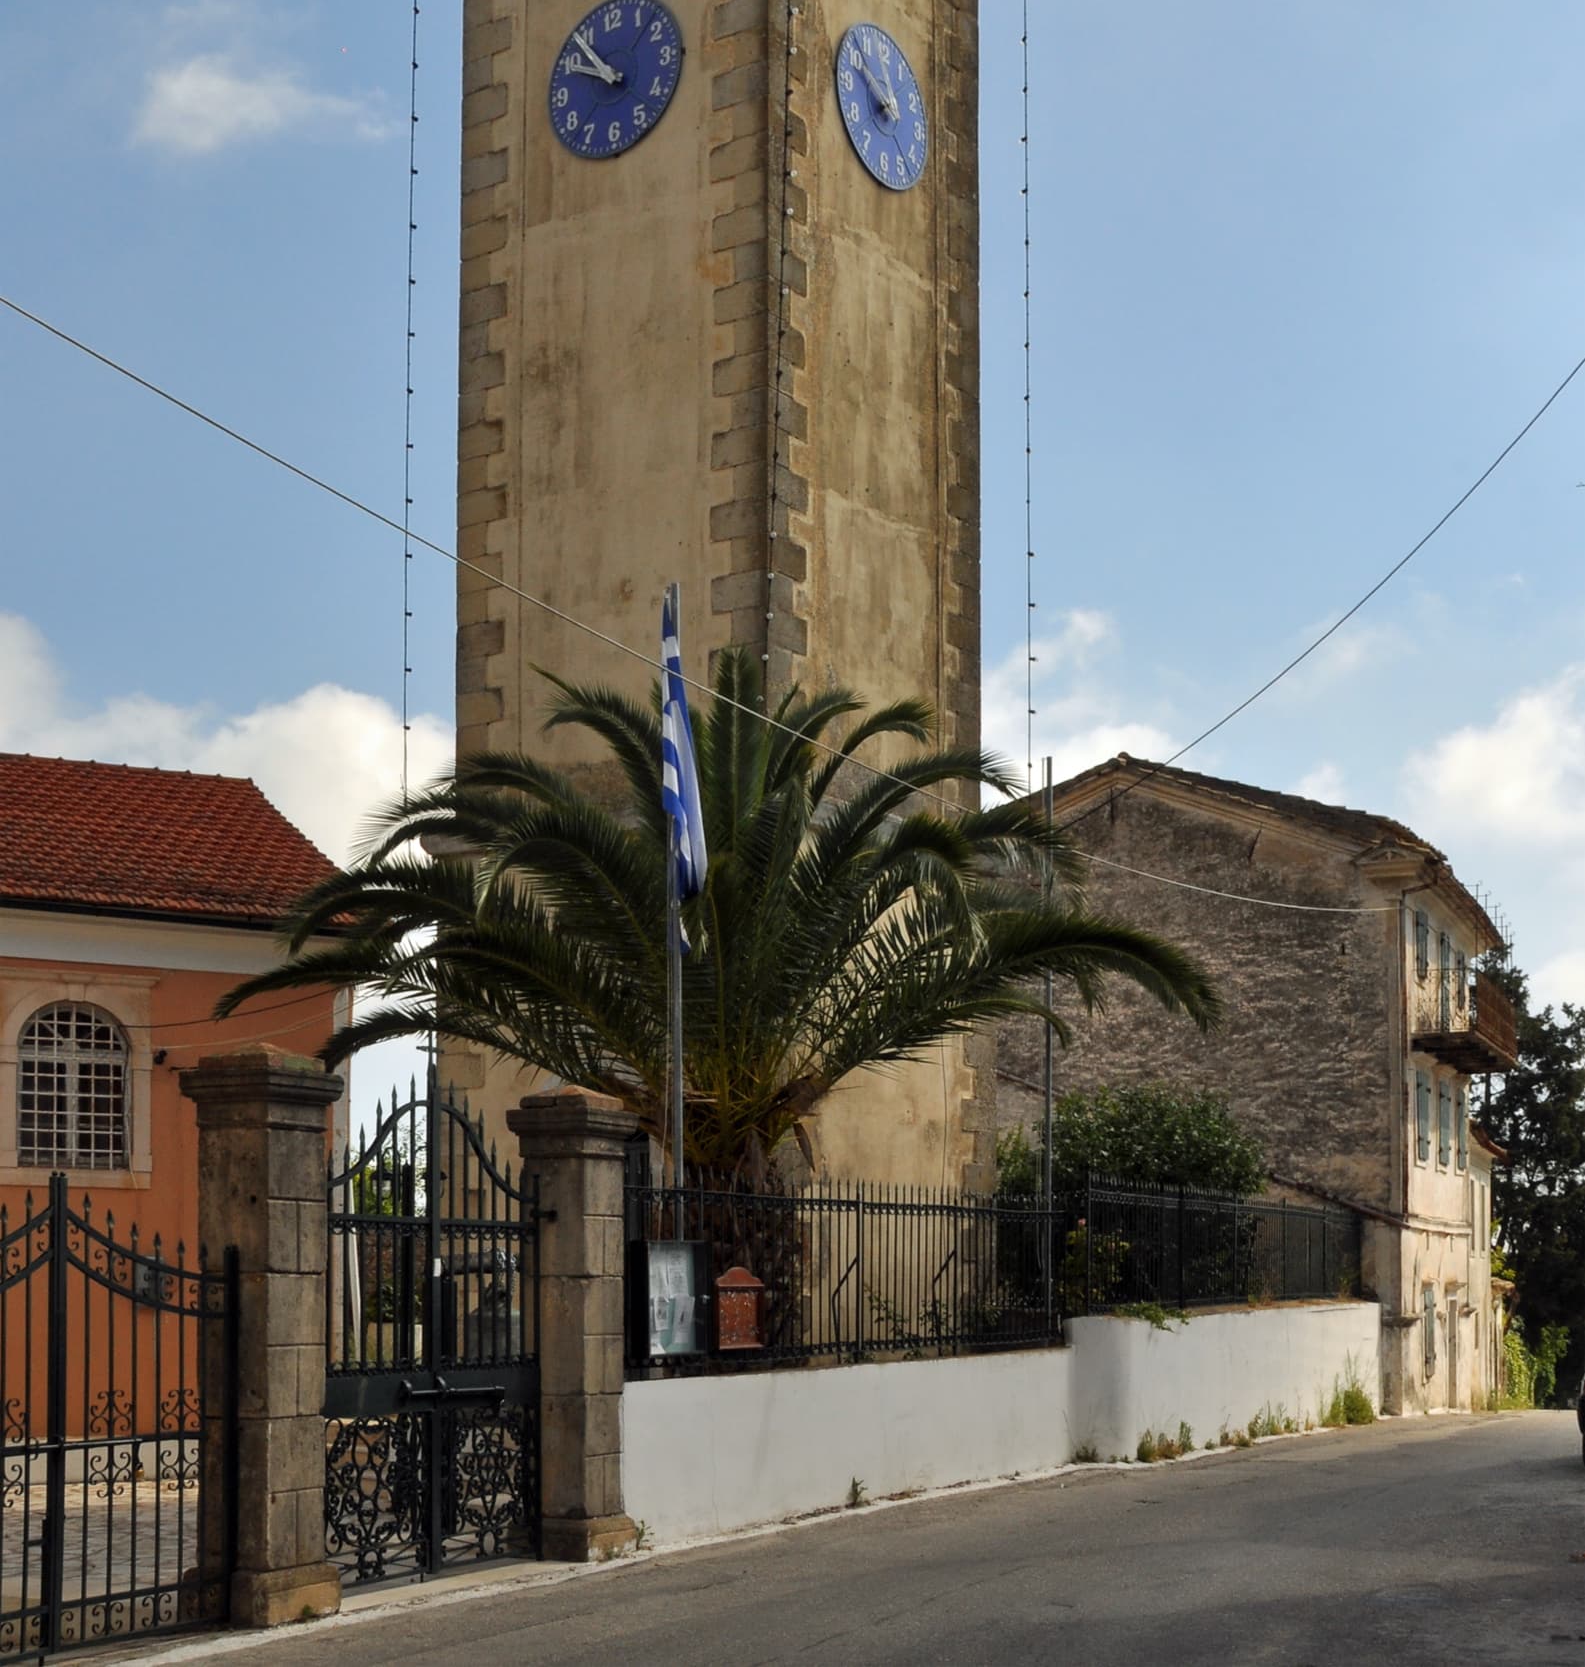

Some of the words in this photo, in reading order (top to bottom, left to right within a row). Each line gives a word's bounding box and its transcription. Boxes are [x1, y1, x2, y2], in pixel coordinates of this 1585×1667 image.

[604, 9, 622, 32] 12
[634, 8, 641, 27] 1
[583, 26, 594, 45] 11
[650, 21, 662, 42] 2
[659, 46, 671, 66] 3
[862, 36, 871, 56] 11
[878, 41, 890, 65] 12
[560, 52, 581, 75] 10
[849, 47, 862, 70] 10
[844, 71, 853, 91] 9
[897, 63, 902, 81] 1
[650, 76, 661, 96] 4
[557, 87, 568, 107] 9
[909, 93, 917, 113] 2
[567, 111, 578, 130] 8
[633, 104, 646, 125] 5
[851, 102, 859, 122] 8
[584, 124, 595, 144] 7
[608, 121, 621, 142] 6
[862, 129, 871, 151] 7
[914, 122, 922, 142] 3
[880, 152, 889, 172] 6
[908, 144, 916, 164] 4
[896, 157, 904, 176] 5
